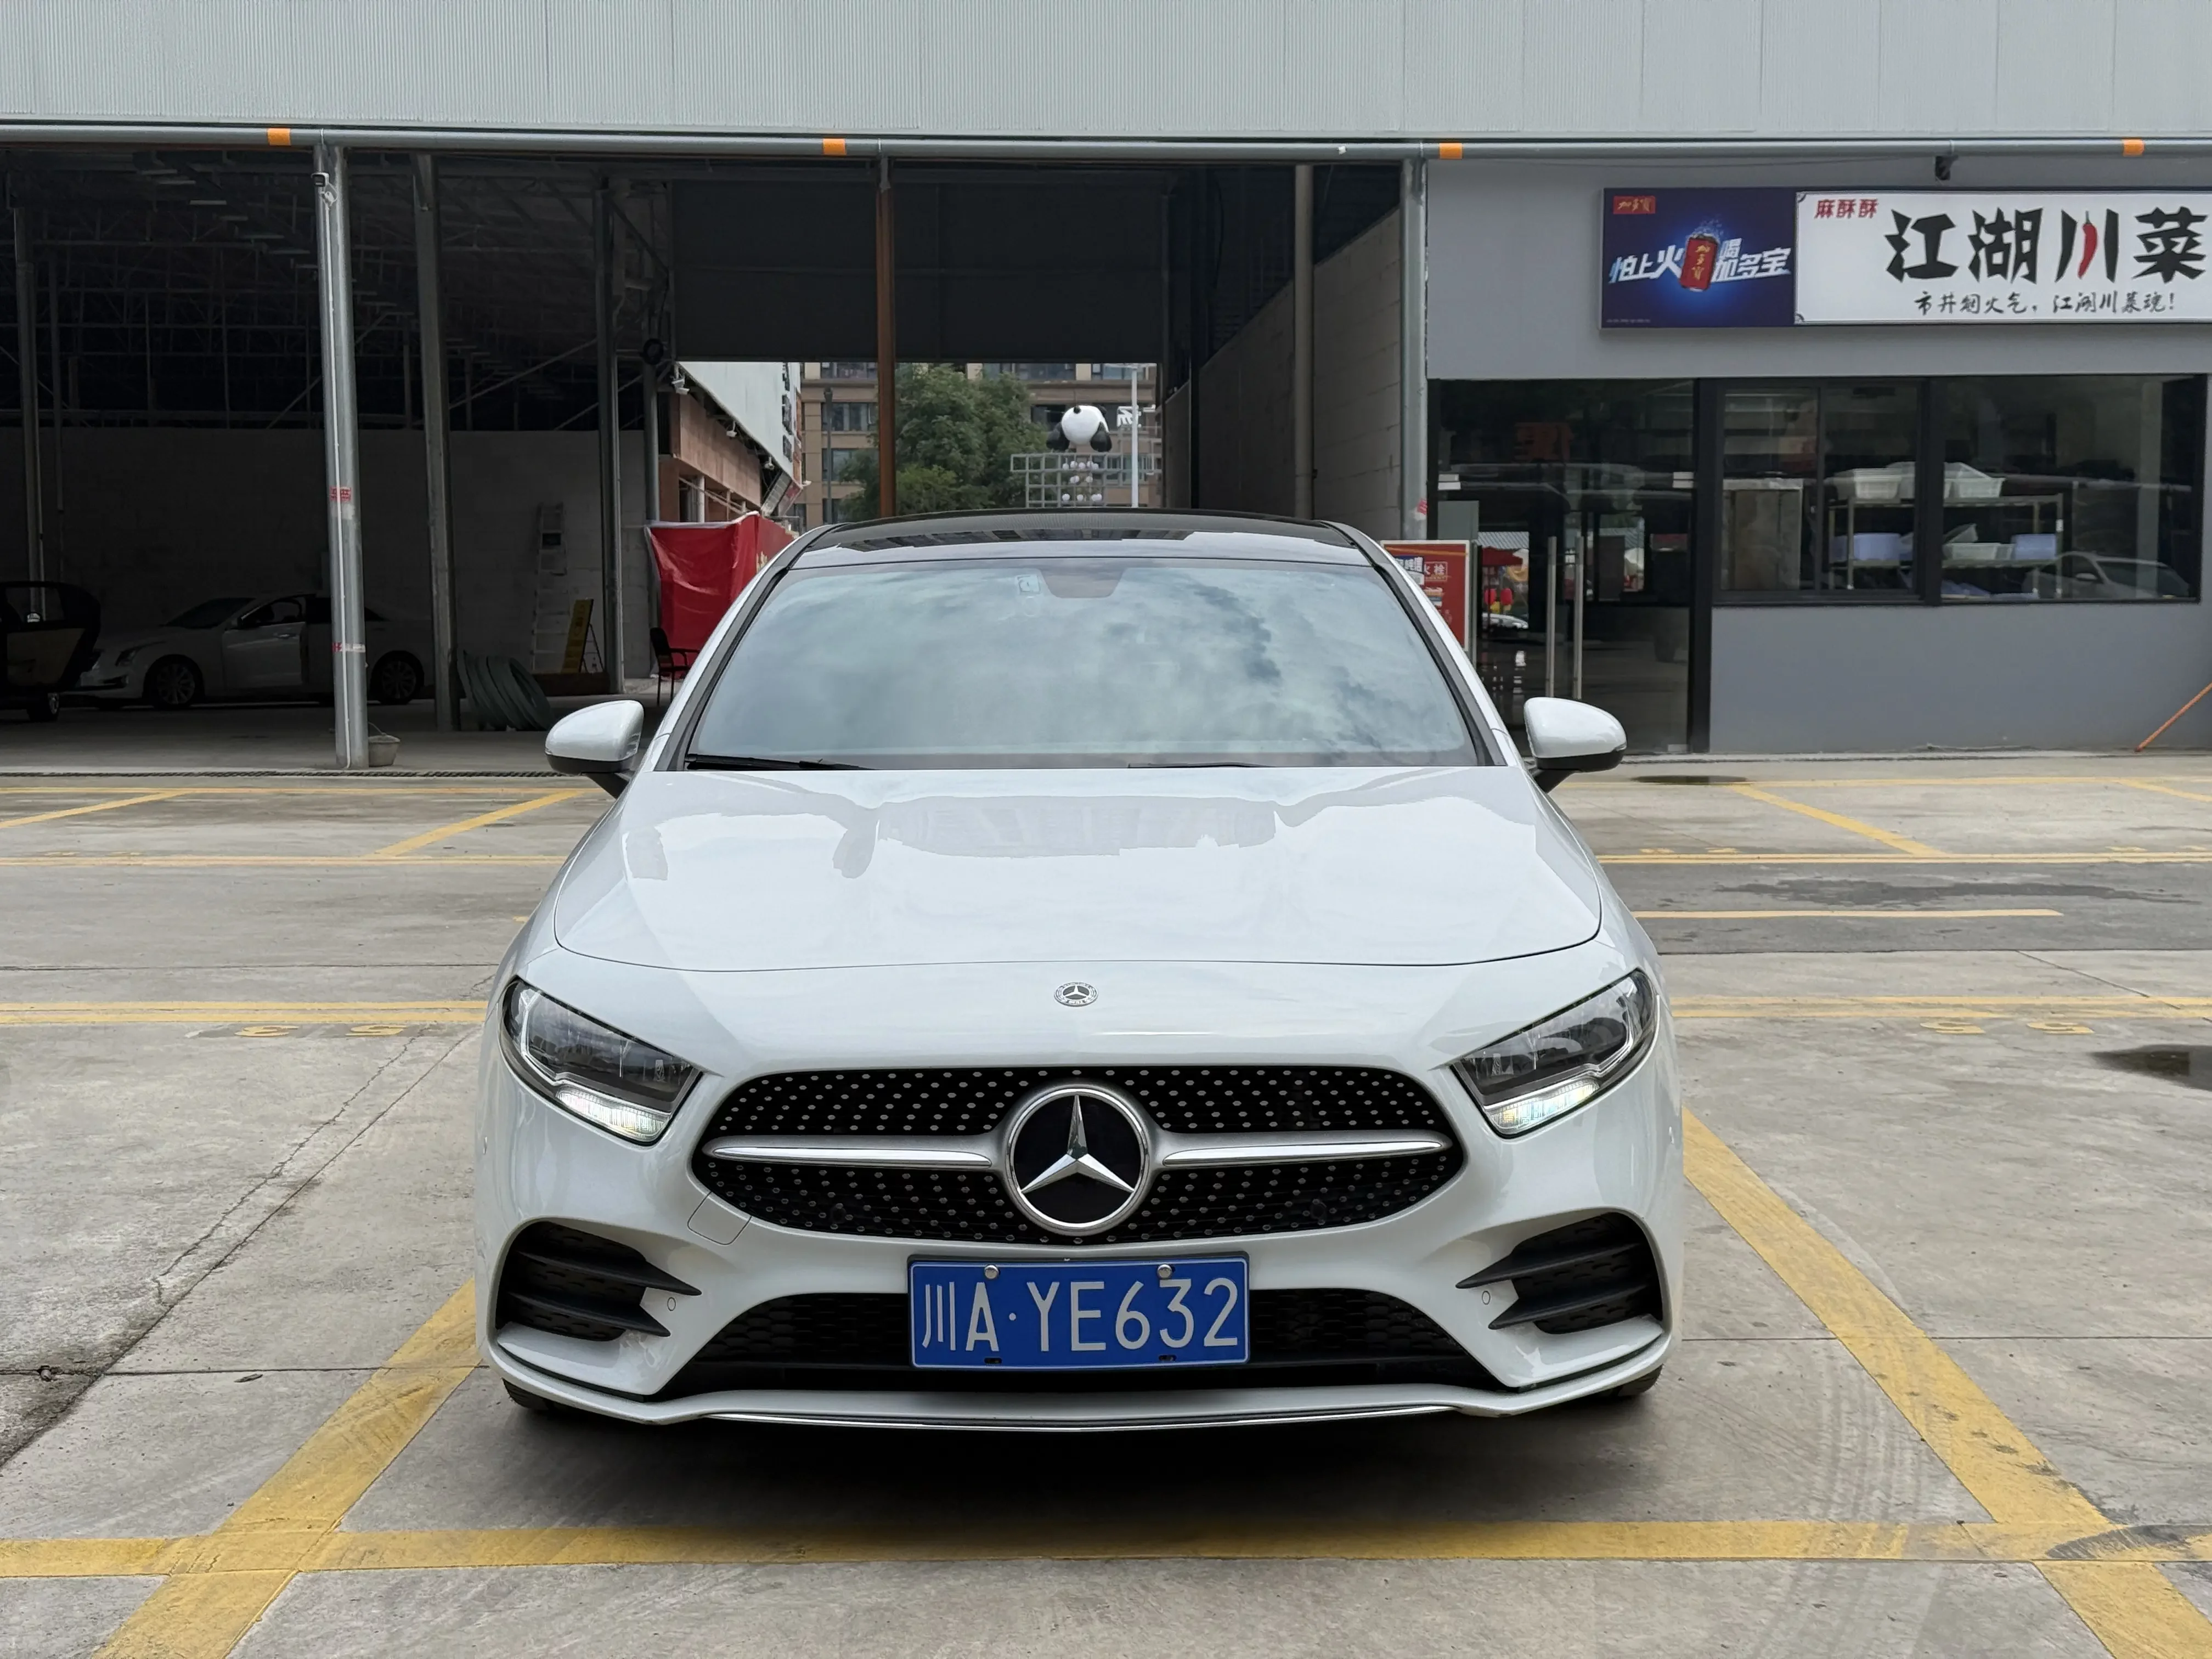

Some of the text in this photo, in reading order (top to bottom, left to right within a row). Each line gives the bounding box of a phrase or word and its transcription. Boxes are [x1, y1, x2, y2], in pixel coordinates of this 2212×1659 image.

[1814, 199, 1879, 219] 麻酥酥
[1608, 244, 1686, 284] 怕上火
[1883, 206, 2209, 284] 江湖川菜
